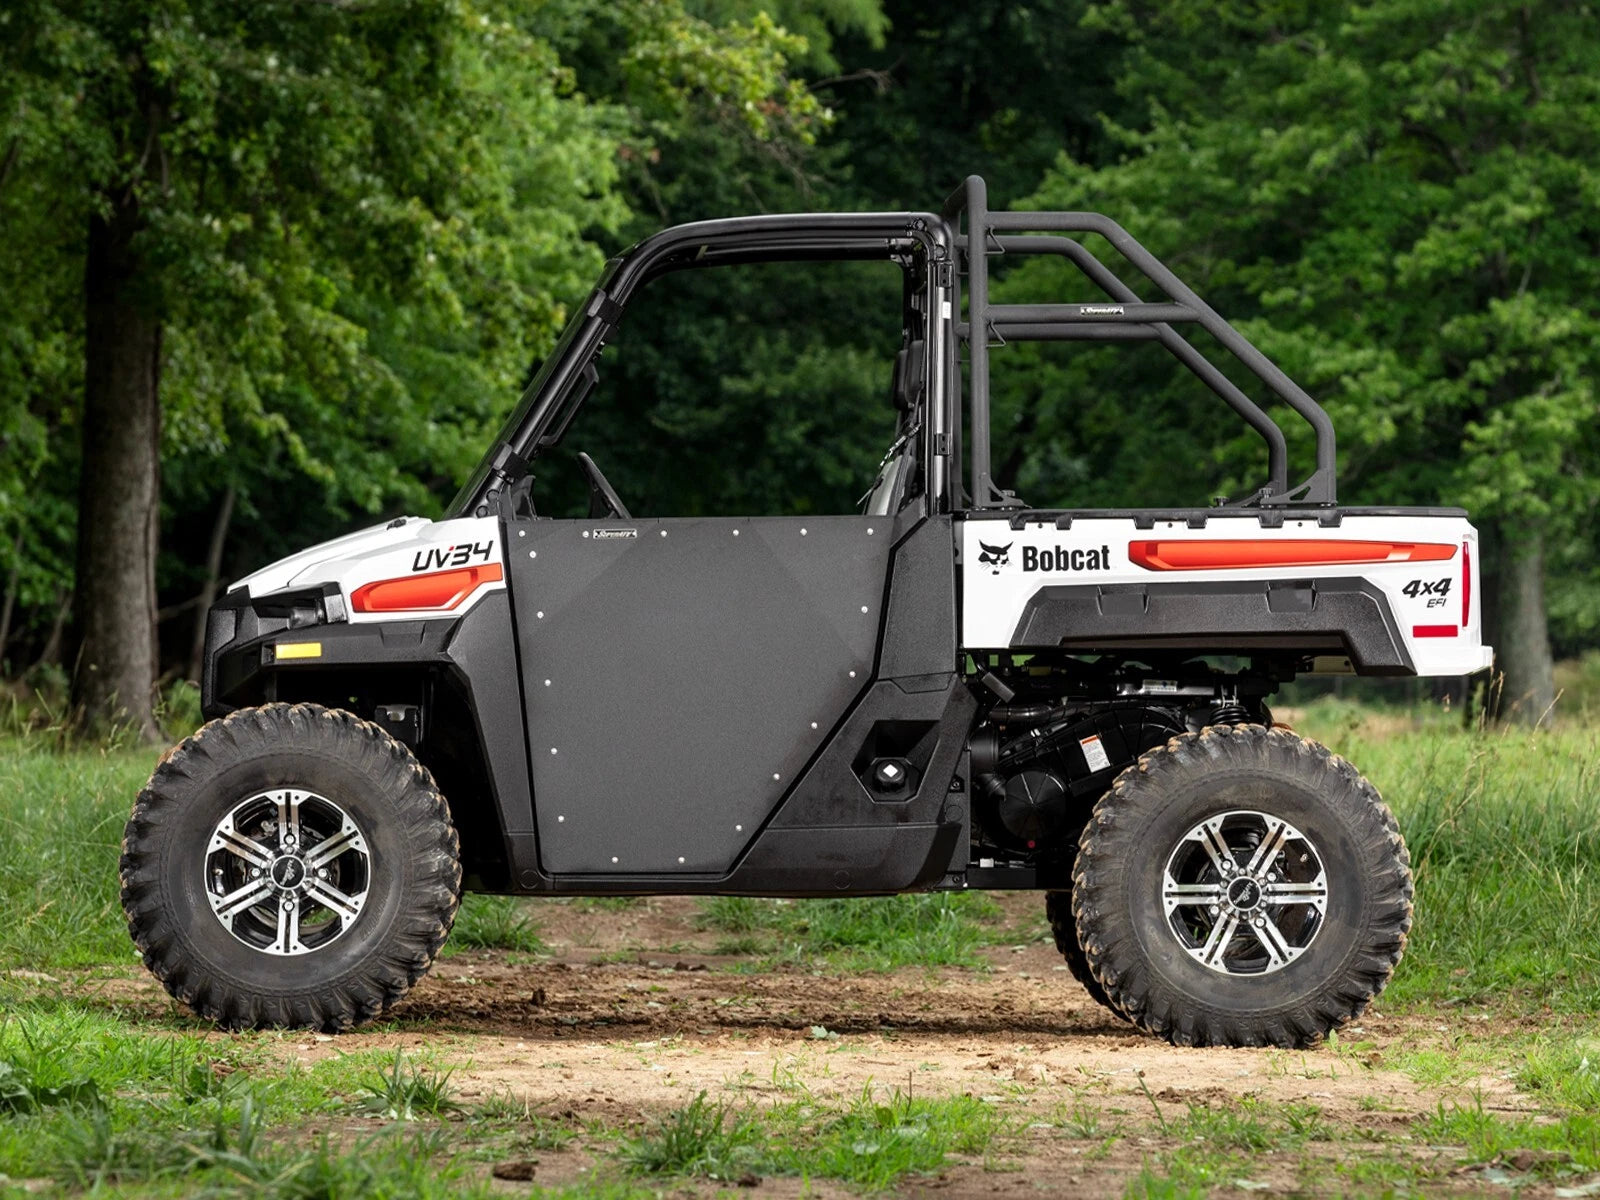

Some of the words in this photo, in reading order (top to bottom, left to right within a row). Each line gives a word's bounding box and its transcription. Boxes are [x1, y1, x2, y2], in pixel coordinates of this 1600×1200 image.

[412, 540, 494, 572] UV34
[1022, 544, 1111, 572] Bobcat
[1401, 577, 1453, 599] 4x4
[1426, 598, 1447, 608] EFI
